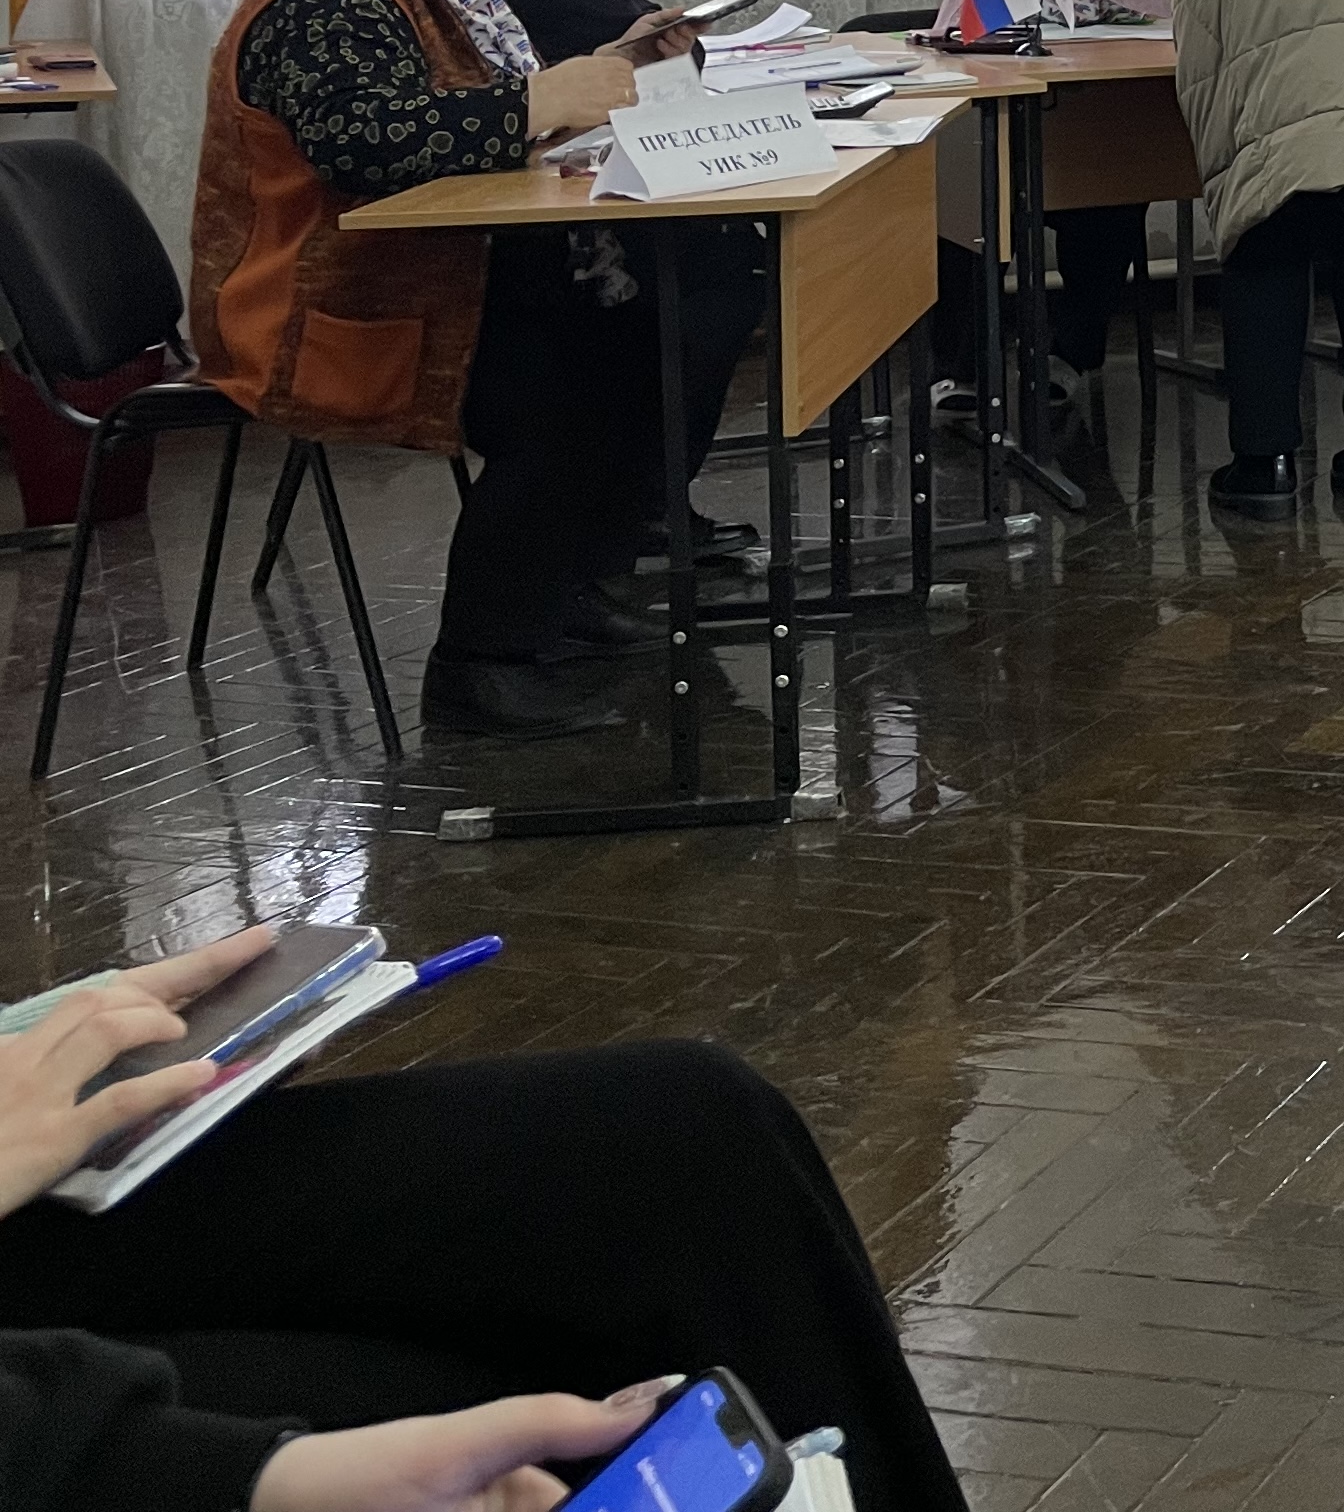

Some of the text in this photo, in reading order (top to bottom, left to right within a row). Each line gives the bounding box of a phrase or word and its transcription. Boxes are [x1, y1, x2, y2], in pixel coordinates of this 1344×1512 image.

[637, 113, 803, 153] ПРЕДСЕДАТЕЛЬ
[698, 148, 779, 176] УИК №9
